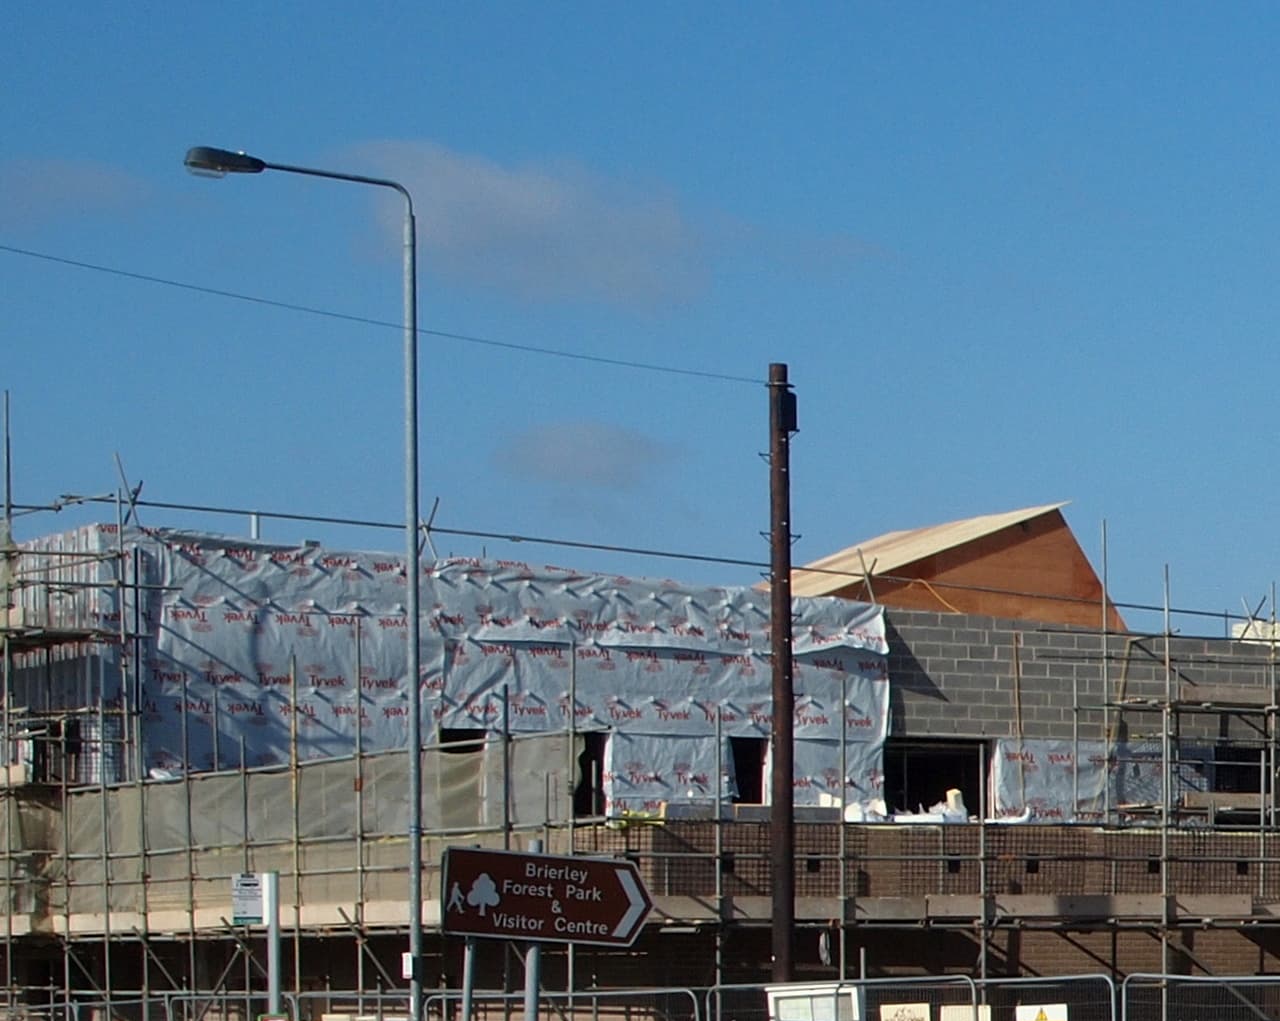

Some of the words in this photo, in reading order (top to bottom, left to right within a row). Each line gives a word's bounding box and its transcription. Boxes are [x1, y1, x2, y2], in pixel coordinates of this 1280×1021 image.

[170, 609, 208, 624] Tyvek
[275, 612, 313, 628] Tyvek
[309, 674, 345, 688] Tyvek
[361, 676, 398, 689] Tyvek
[512, 703, 546, 717] Tyvek
[608, 708, 642, 721] Tyvek
[656, 709, 690, 722] Tyvek
[525, 862, 588, 884] Brierley
[502, 879, 554, 899] Forest
[566, 886, 602, 902] Park
[551, 900, 563, 914] &
[492, 912, 545, 931] Visitor
[554, 917, 609, 935] Centre
